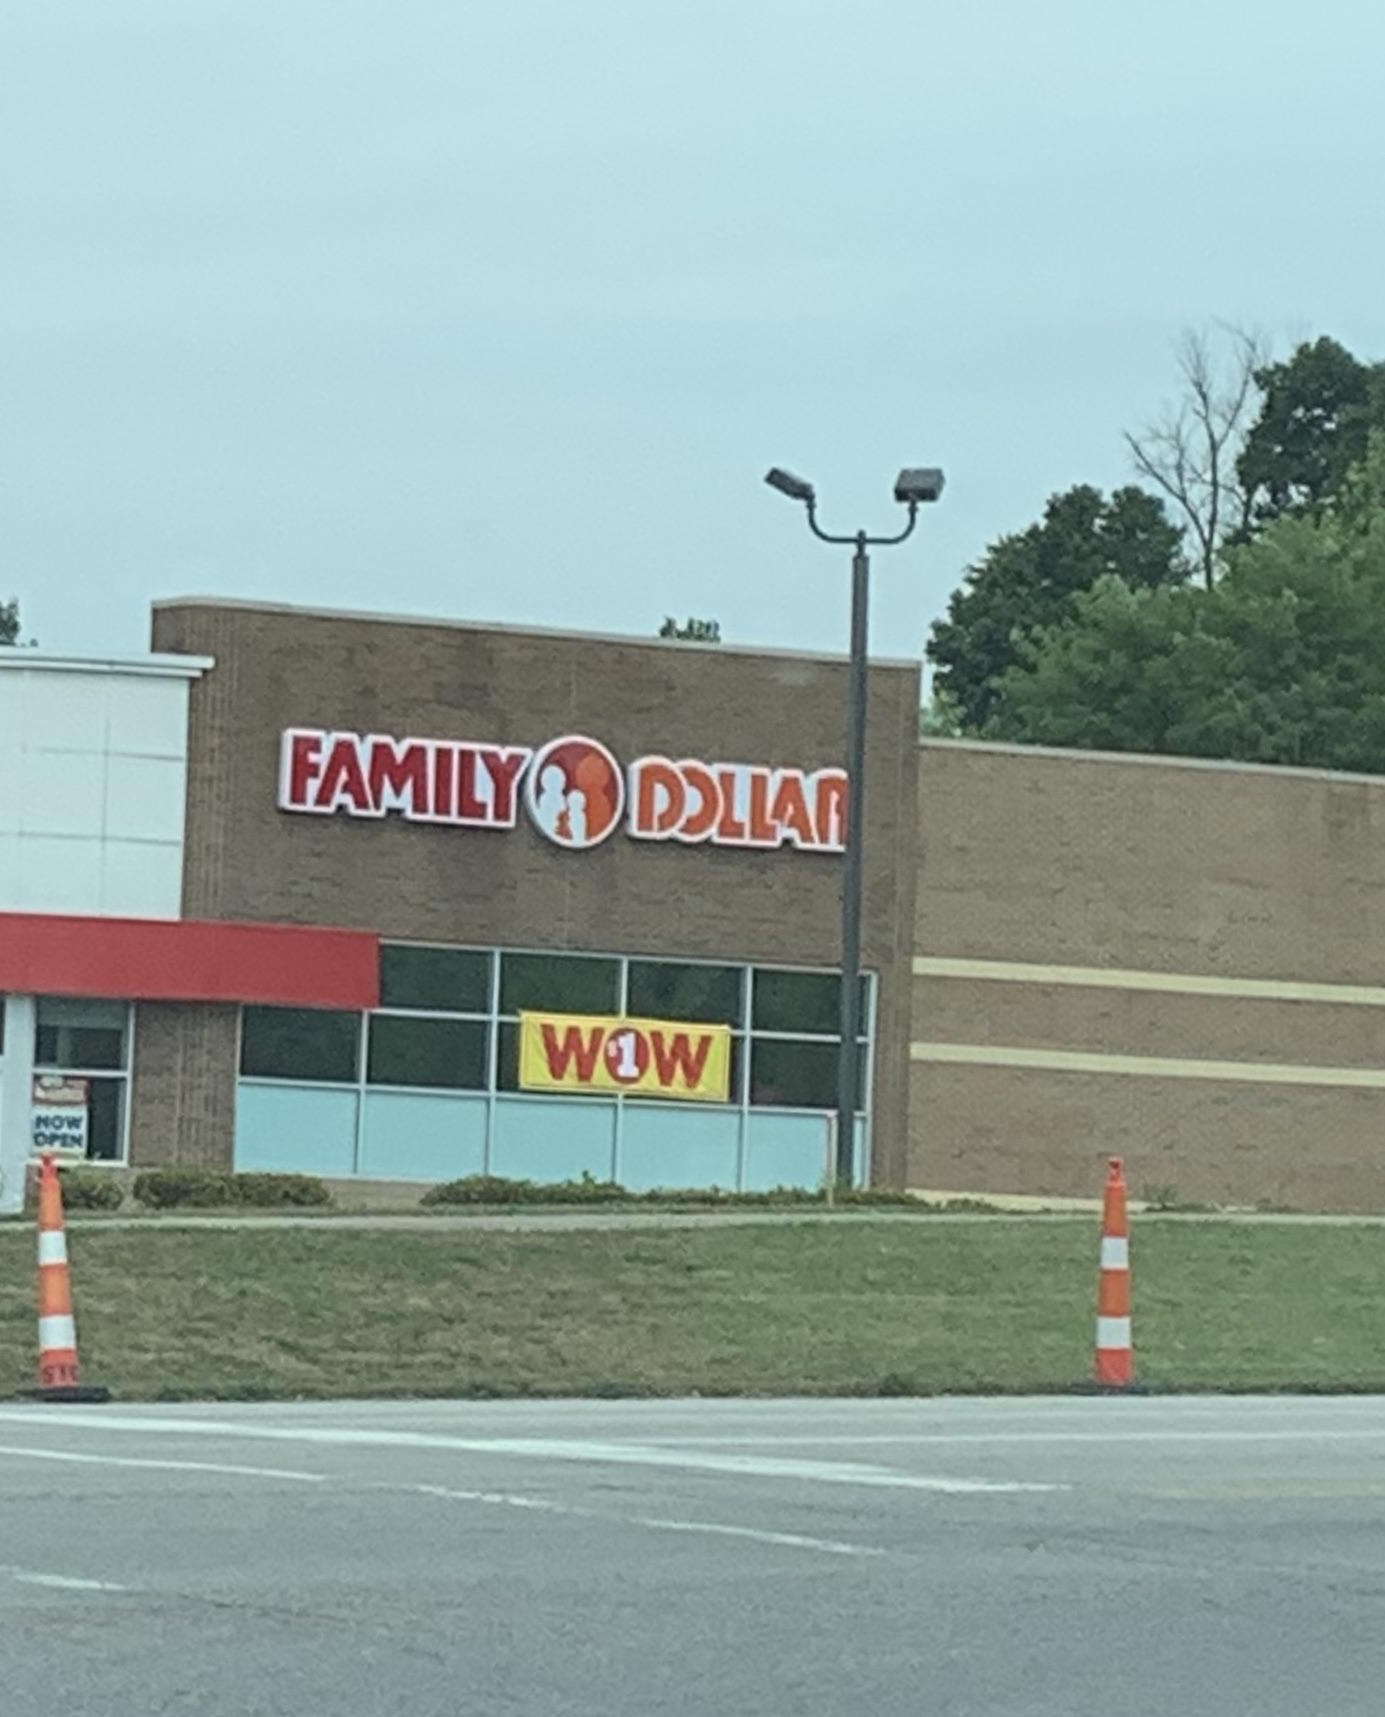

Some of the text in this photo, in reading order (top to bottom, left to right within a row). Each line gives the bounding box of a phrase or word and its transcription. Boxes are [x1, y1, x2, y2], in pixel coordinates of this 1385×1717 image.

[288, 732, 850, 848] FAMILY DOLLAR
[540, 1023, 712, 1088] WOW
[33, 1132, 83, 1148] OPEN
[35, 1115, 83, 1130] NOW
